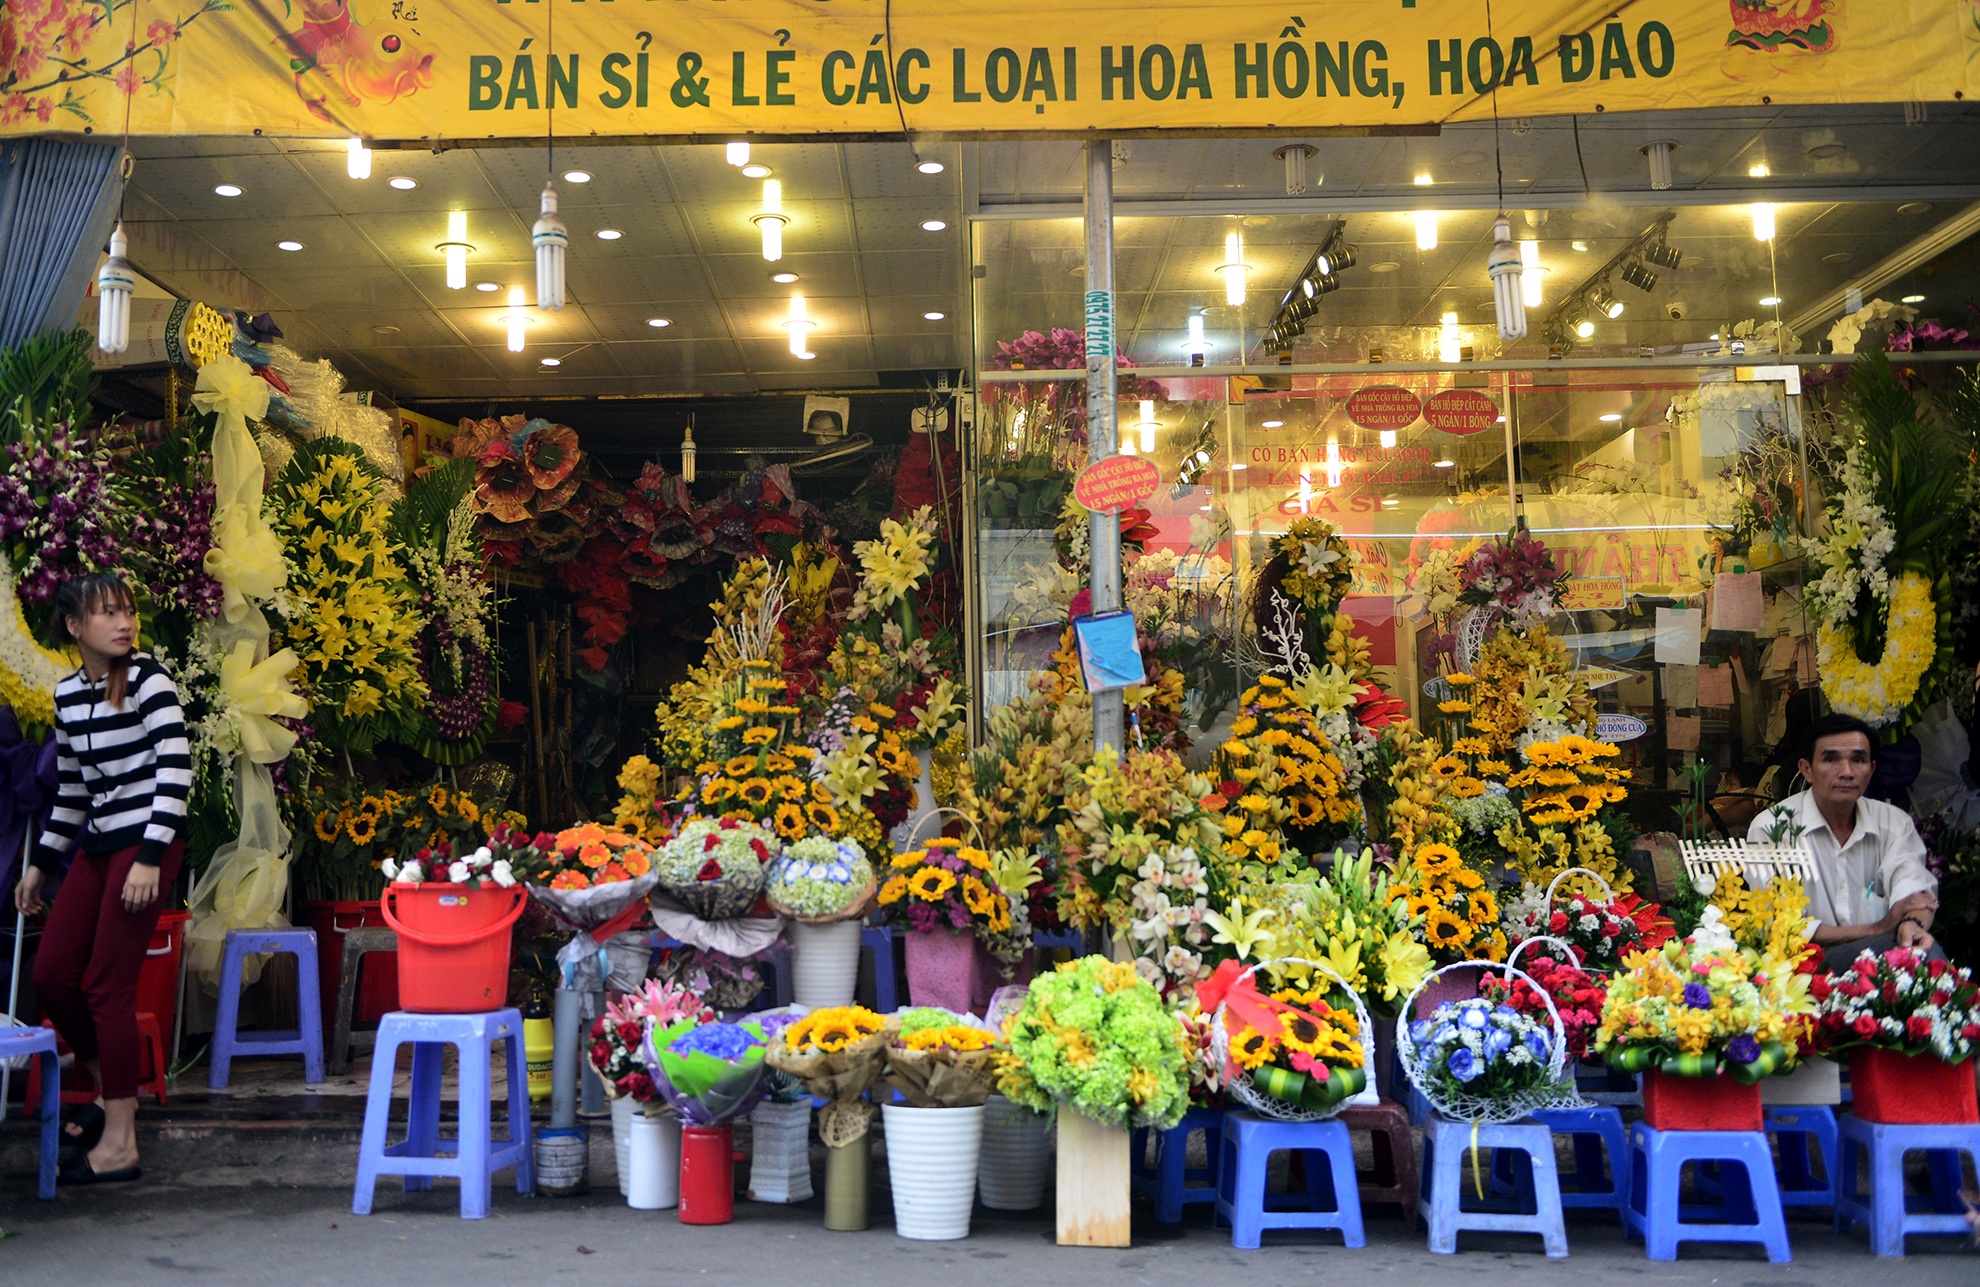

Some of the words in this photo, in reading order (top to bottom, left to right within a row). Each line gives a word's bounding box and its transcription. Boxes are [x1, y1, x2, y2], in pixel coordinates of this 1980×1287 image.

[469, 38, 579, 111] BÁN
[599, 31, 653, 108] SỈ
[671, 51, 710, 108] &
[732, 29, 797, 107] LẺ
[821, 34, 931, 105] CÁC
[953, 47, 1077, 114] LOẠI
[1101, 44, 1213, 100] HOA
[1234, 16, 1405, 109] HỒNG,
[1427, 36, 1541, 96] HOA
[1086, 291, 1109, 315] 0975
[1086, 316, 1109, 327] 27
[146, 325, 156, 358] QUANTITY
[1086, 329, 1109, 341] 27
[1086, 343, 1109, 356] 27
[1356, 392, 1367, 402] BÁN
[1367, 391, 1379, 402] GỐC
[1430, 397, 1442, 411] BÁN
[1442, 395, 1451, 411] HỒ
[1451, 397, 1464, 413] ĐIỆP
[1361, 403, 1374, 412] NHÀ
[1396, 404, 1405, 412] RA
[1406, 404, 1419, 412] HOA
[1356, 415, 1365, 424] 15
[1398, 412, 1414, 423] GỐC
[1431, 414, 1437, 427] 5
[1469, 412, 1491, 428] BÔNG
[1252, 442, 1271, 462] CÓ
[1278, 444, 1309, 462] BÁN
[1317, 445, 1357, 463] HNG
[1365, 446, 1431, 463] ECUADOR
[1132, 473, 1143, 483] RA
[1142, 470, 1158, 480] HOA
[1268, 473, 1312, 485] LAN
[1363, 466, 1418, 487] ĐIỆP
[1090, 497, 1102, 509] 15
[1137, 481, 1155, 497] GỐC
[1278, 491, 1340, 516] GIÁ
[1350, 487, 1384, 513] SỈ
[1583, 582, 1598, 592] HOA
